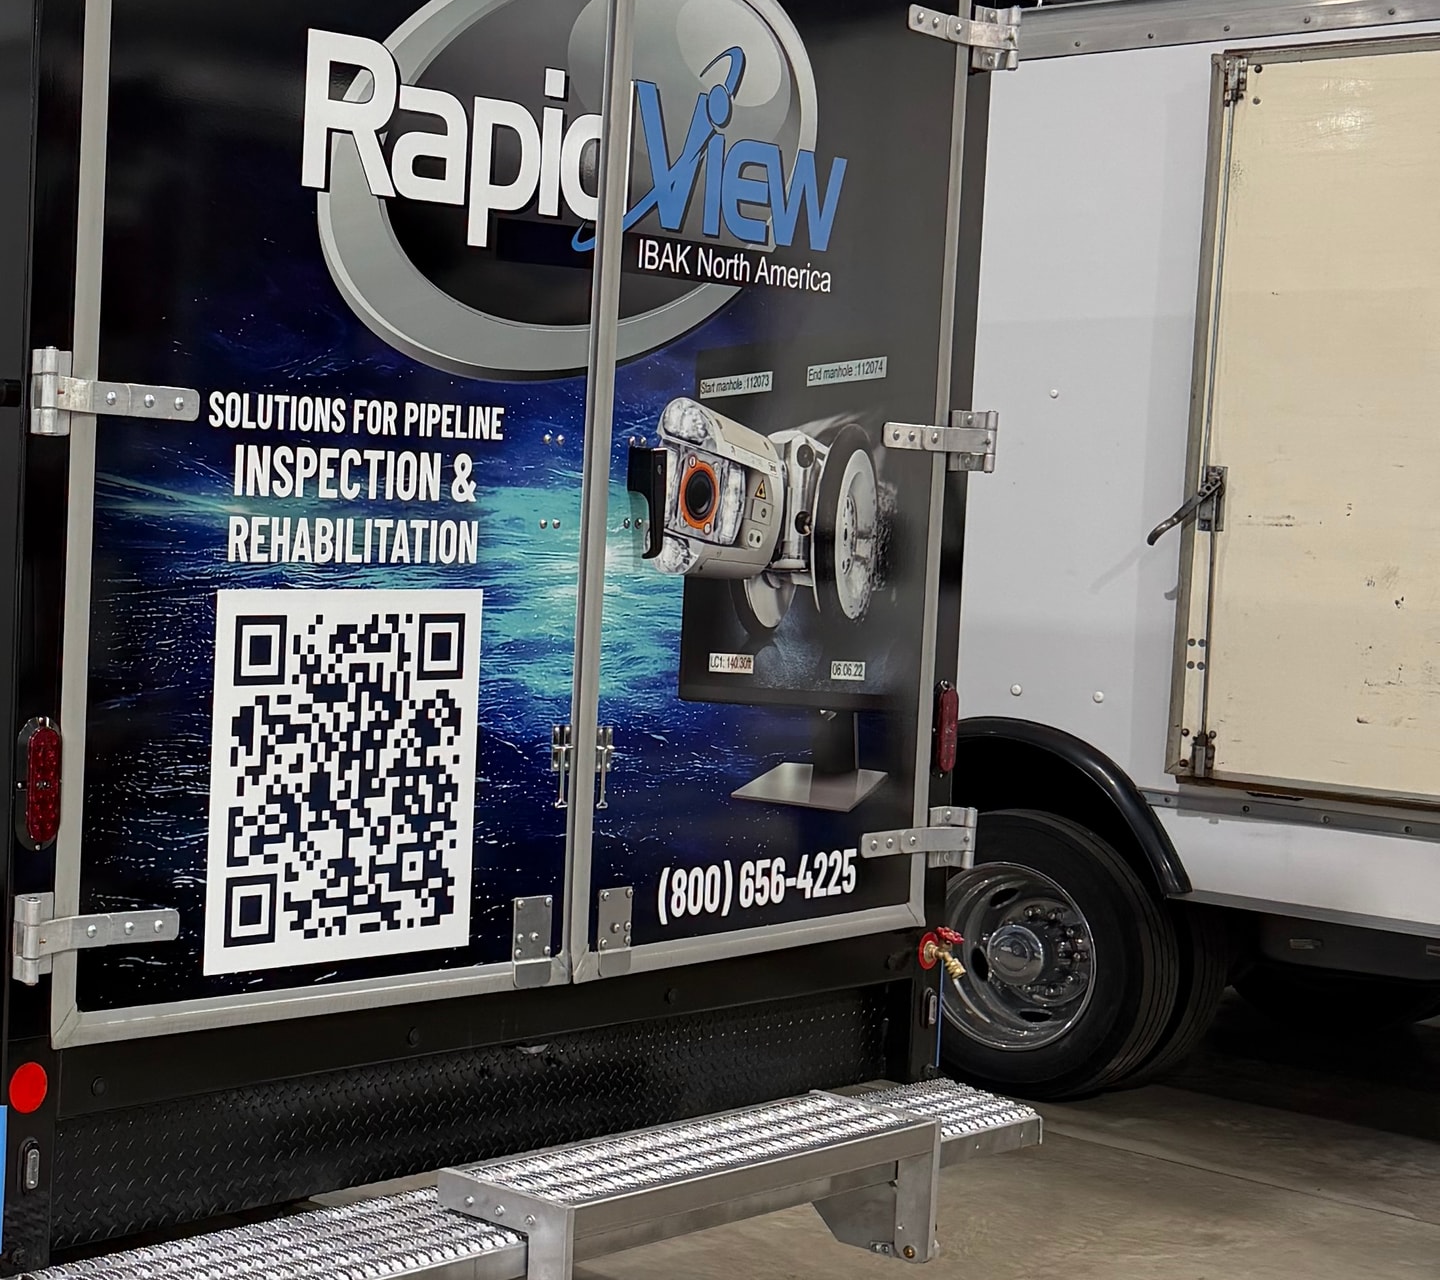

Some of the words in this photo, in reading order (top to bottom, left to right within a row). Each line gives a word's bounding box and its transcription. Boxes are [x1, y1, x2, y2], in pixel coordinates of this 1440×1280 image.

[636, 238, 690, 274] IBAK
[696, 246, 752, 283] North
[755, 257, 832, 294] America
[700, 380, 715, 395] Start
[716, 377, 743, 392] manhole
[808, 367, 822, 381] End
[823, 364, 853, 380] manhole
[208, 392, 346, 435] SOLUTIONS
[352, 396, 399, 437] FOR
[404, 402, 505, 441] PIPELINE
[234, 444, 442, 502] INSPECTION
[451, 458, 478, 504] &
[227, 518, 479, 564] REHABILITATION
[657, 860, 733, 925] (800)
[739, 848, 858, 908] 656-4225
